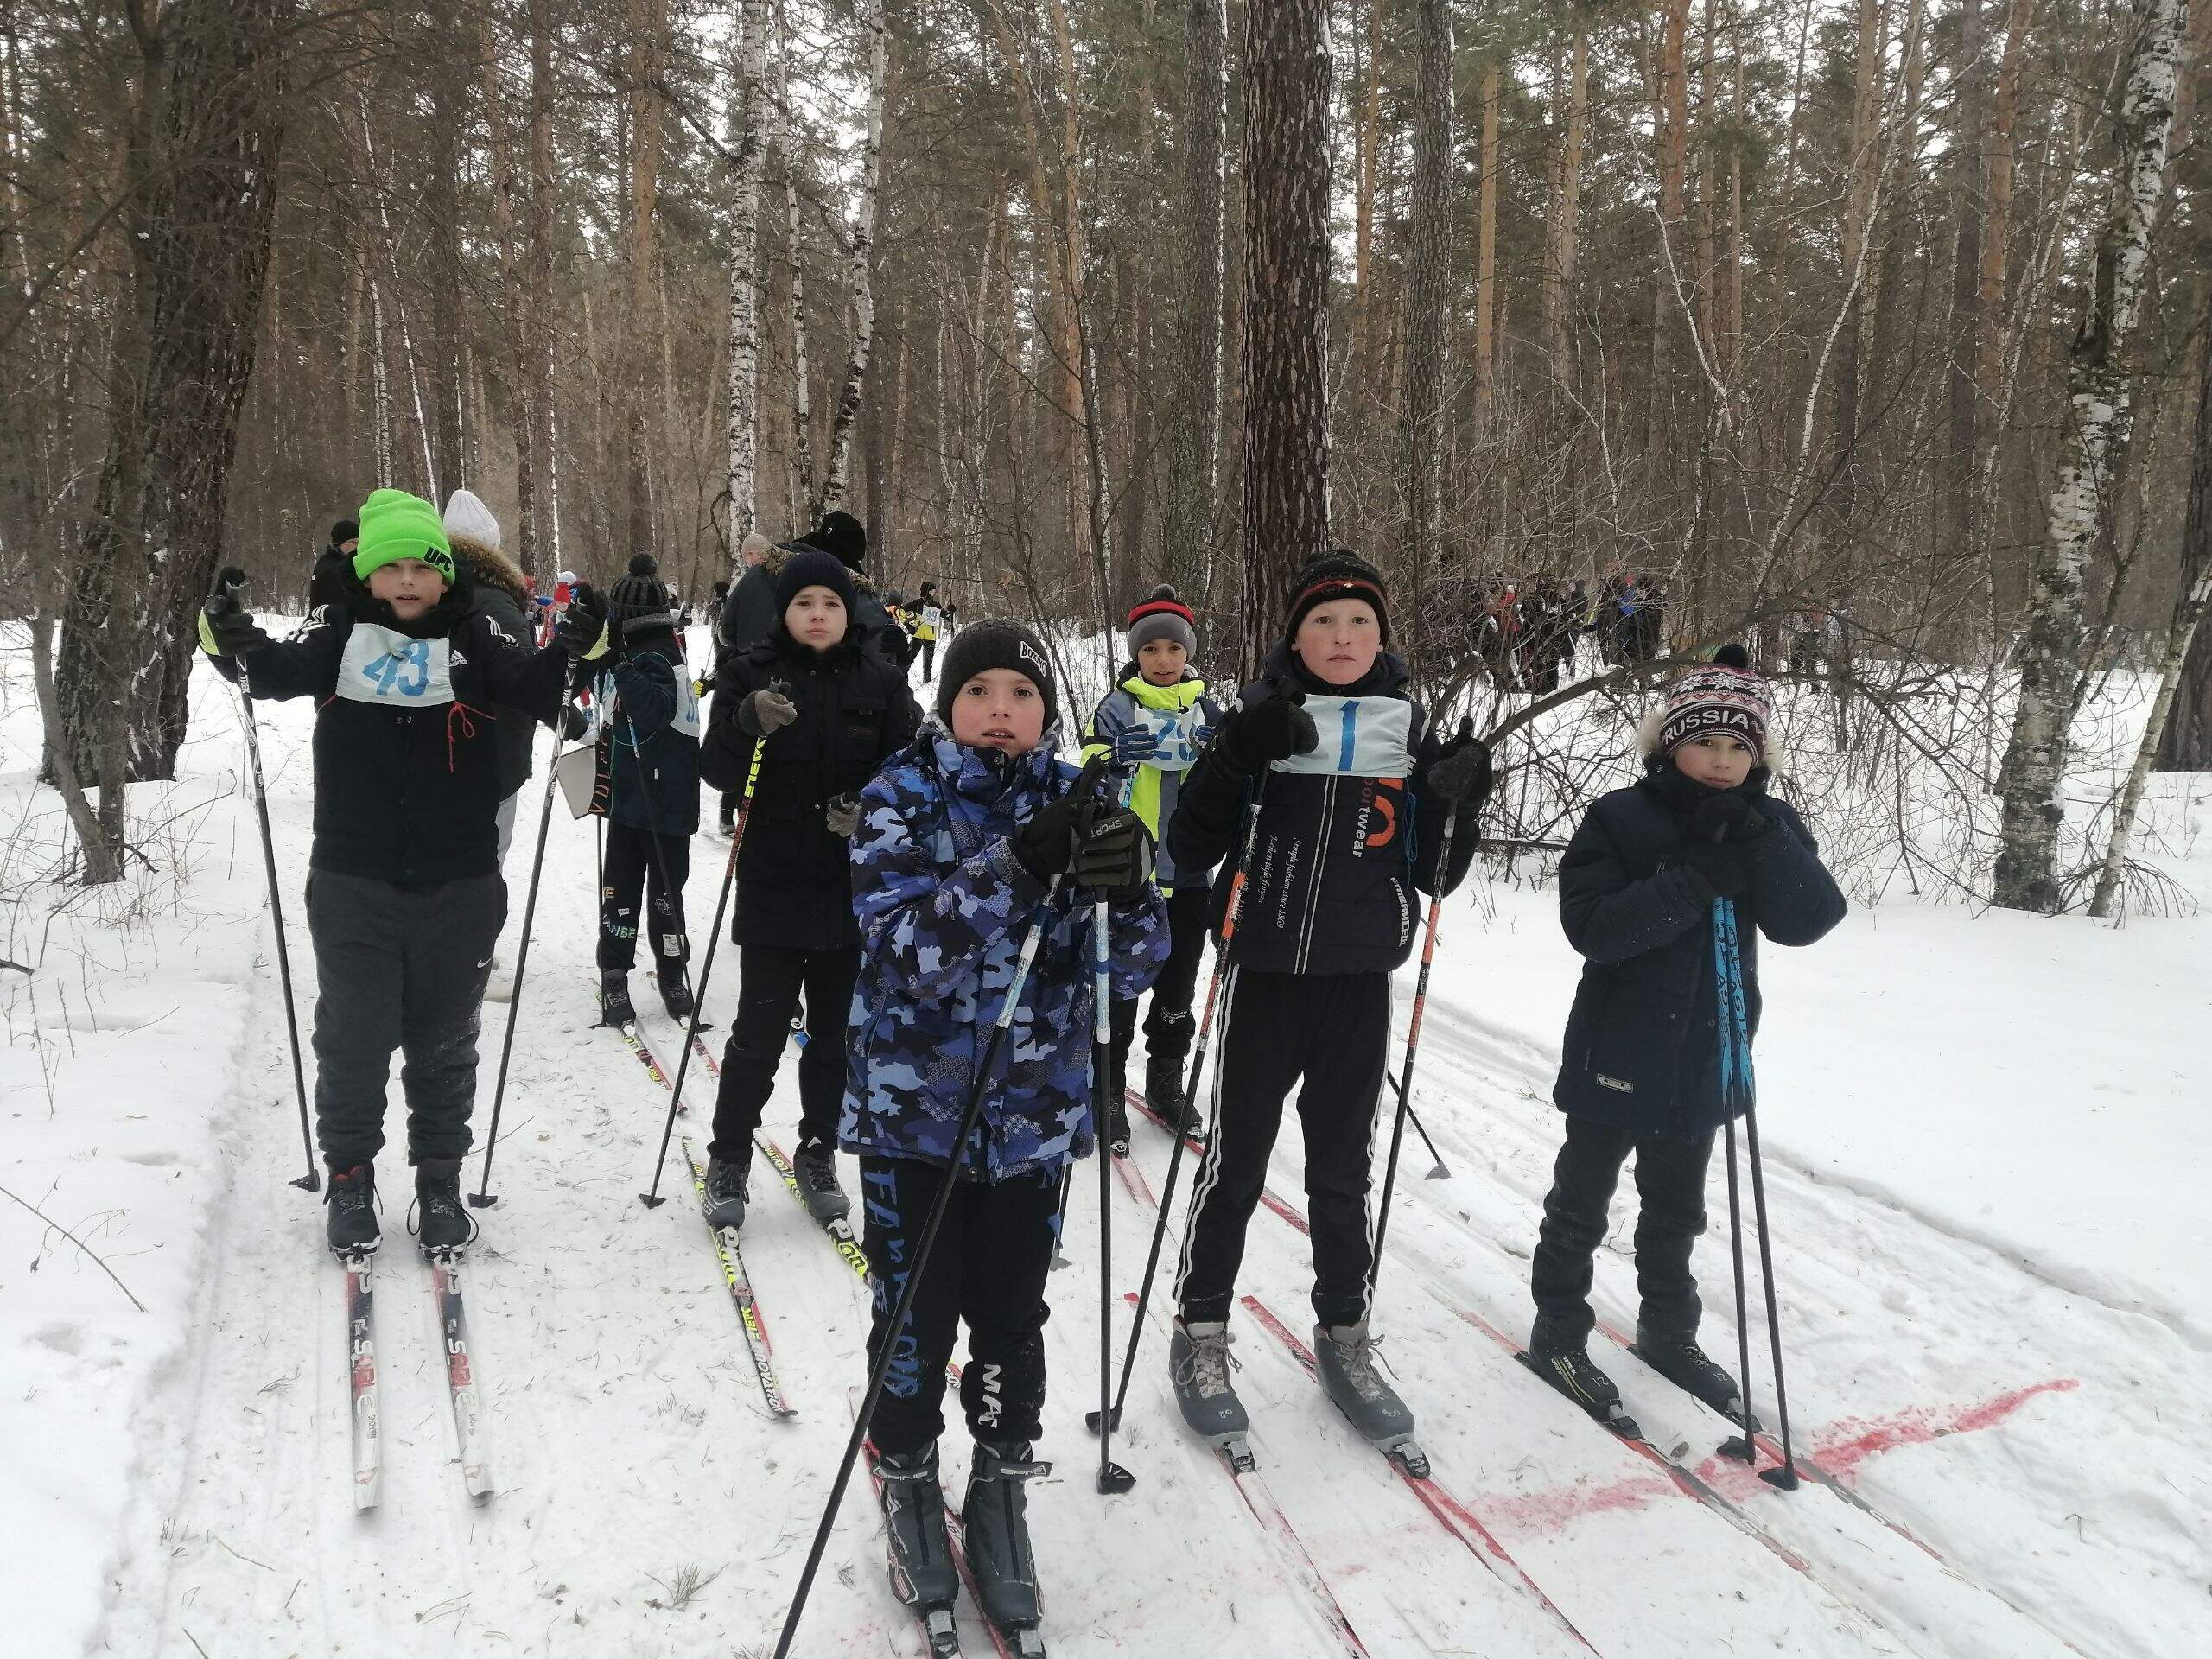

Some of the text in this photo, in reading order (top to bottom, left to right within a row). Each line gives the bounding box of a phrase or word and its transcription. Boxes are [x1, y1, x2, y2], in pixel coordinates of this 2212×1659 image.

[423, 546, 453, 573] UFC
[362, 641, 429, 696] 43
[1020, 641, 1047, 677] BOXING
[1338, 701, 1360, 772] 1
[1663, 709, 1749, 746] RUSSIA
[744, 737, 766, 798] SABLE
[1276, 837, 1302, 929] Simple fashion since 1869
